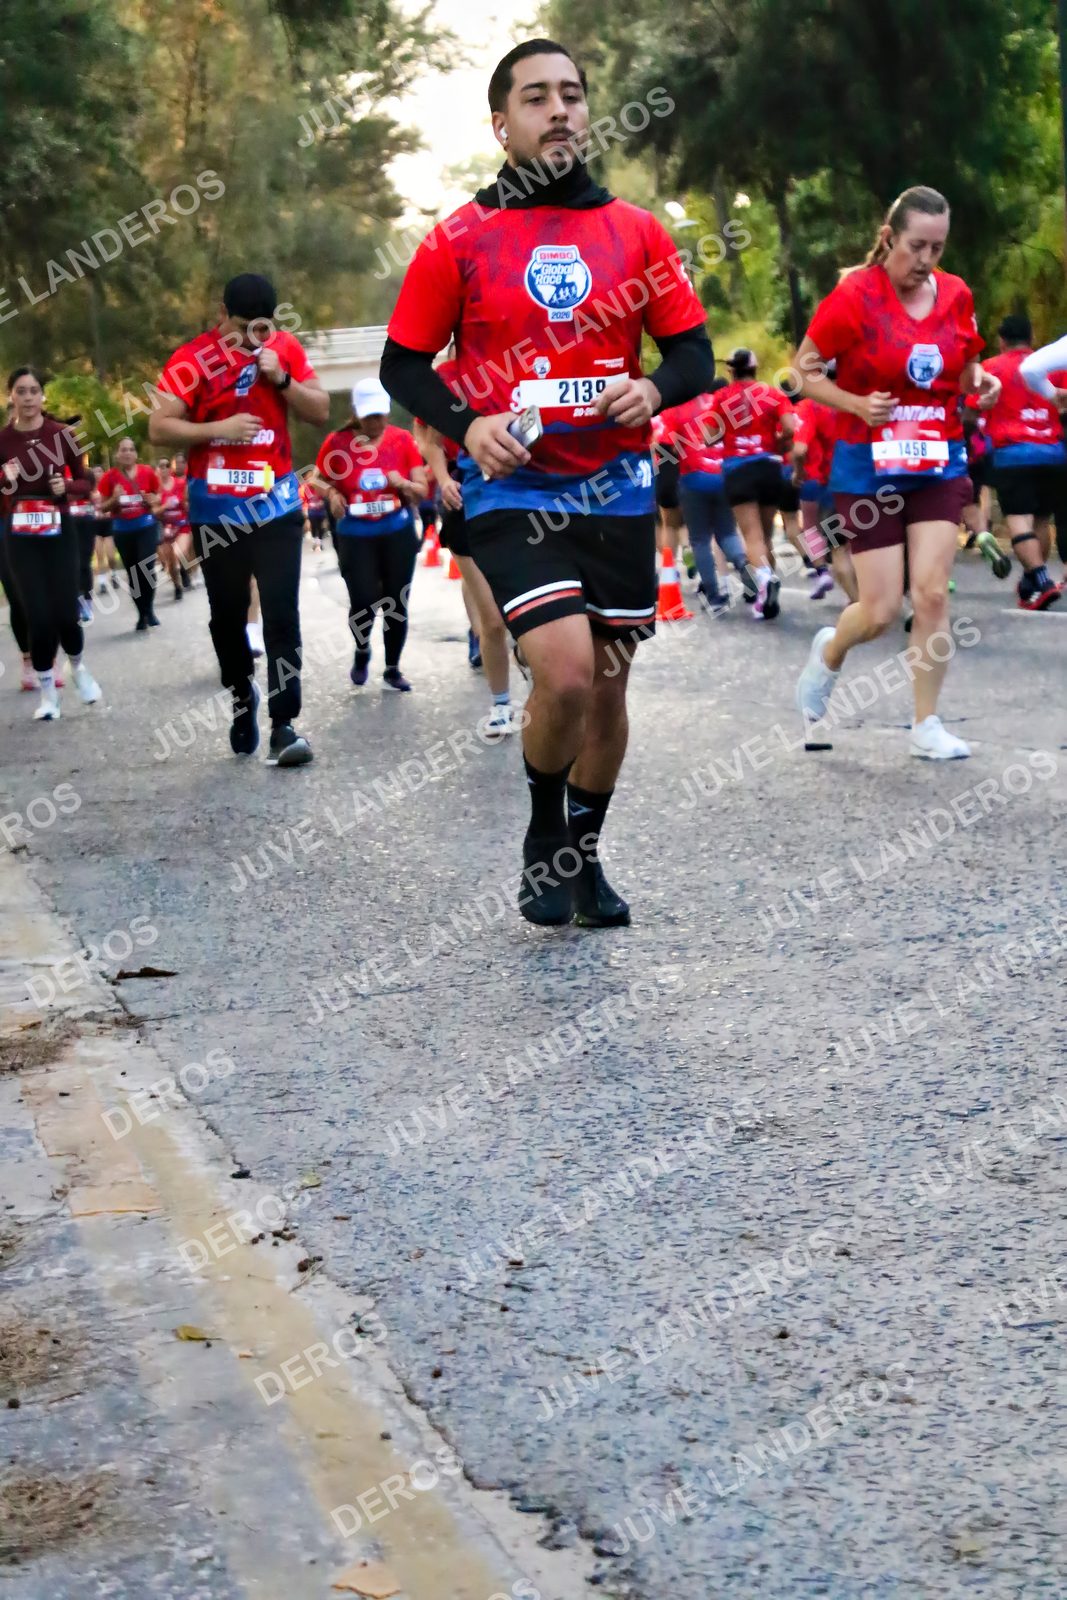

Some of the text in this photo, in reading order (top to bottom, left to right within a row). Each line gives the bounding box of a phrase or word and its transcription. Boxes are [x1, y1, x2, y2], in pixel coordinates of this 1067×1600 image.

[540, 252, 573, 260] BIMBO
[541, 263, 574, 275] Global
[536, 274, 562, 286] Race
[899, 441, 928, 456] 1458
[228, 470, 254, 484] 1336
